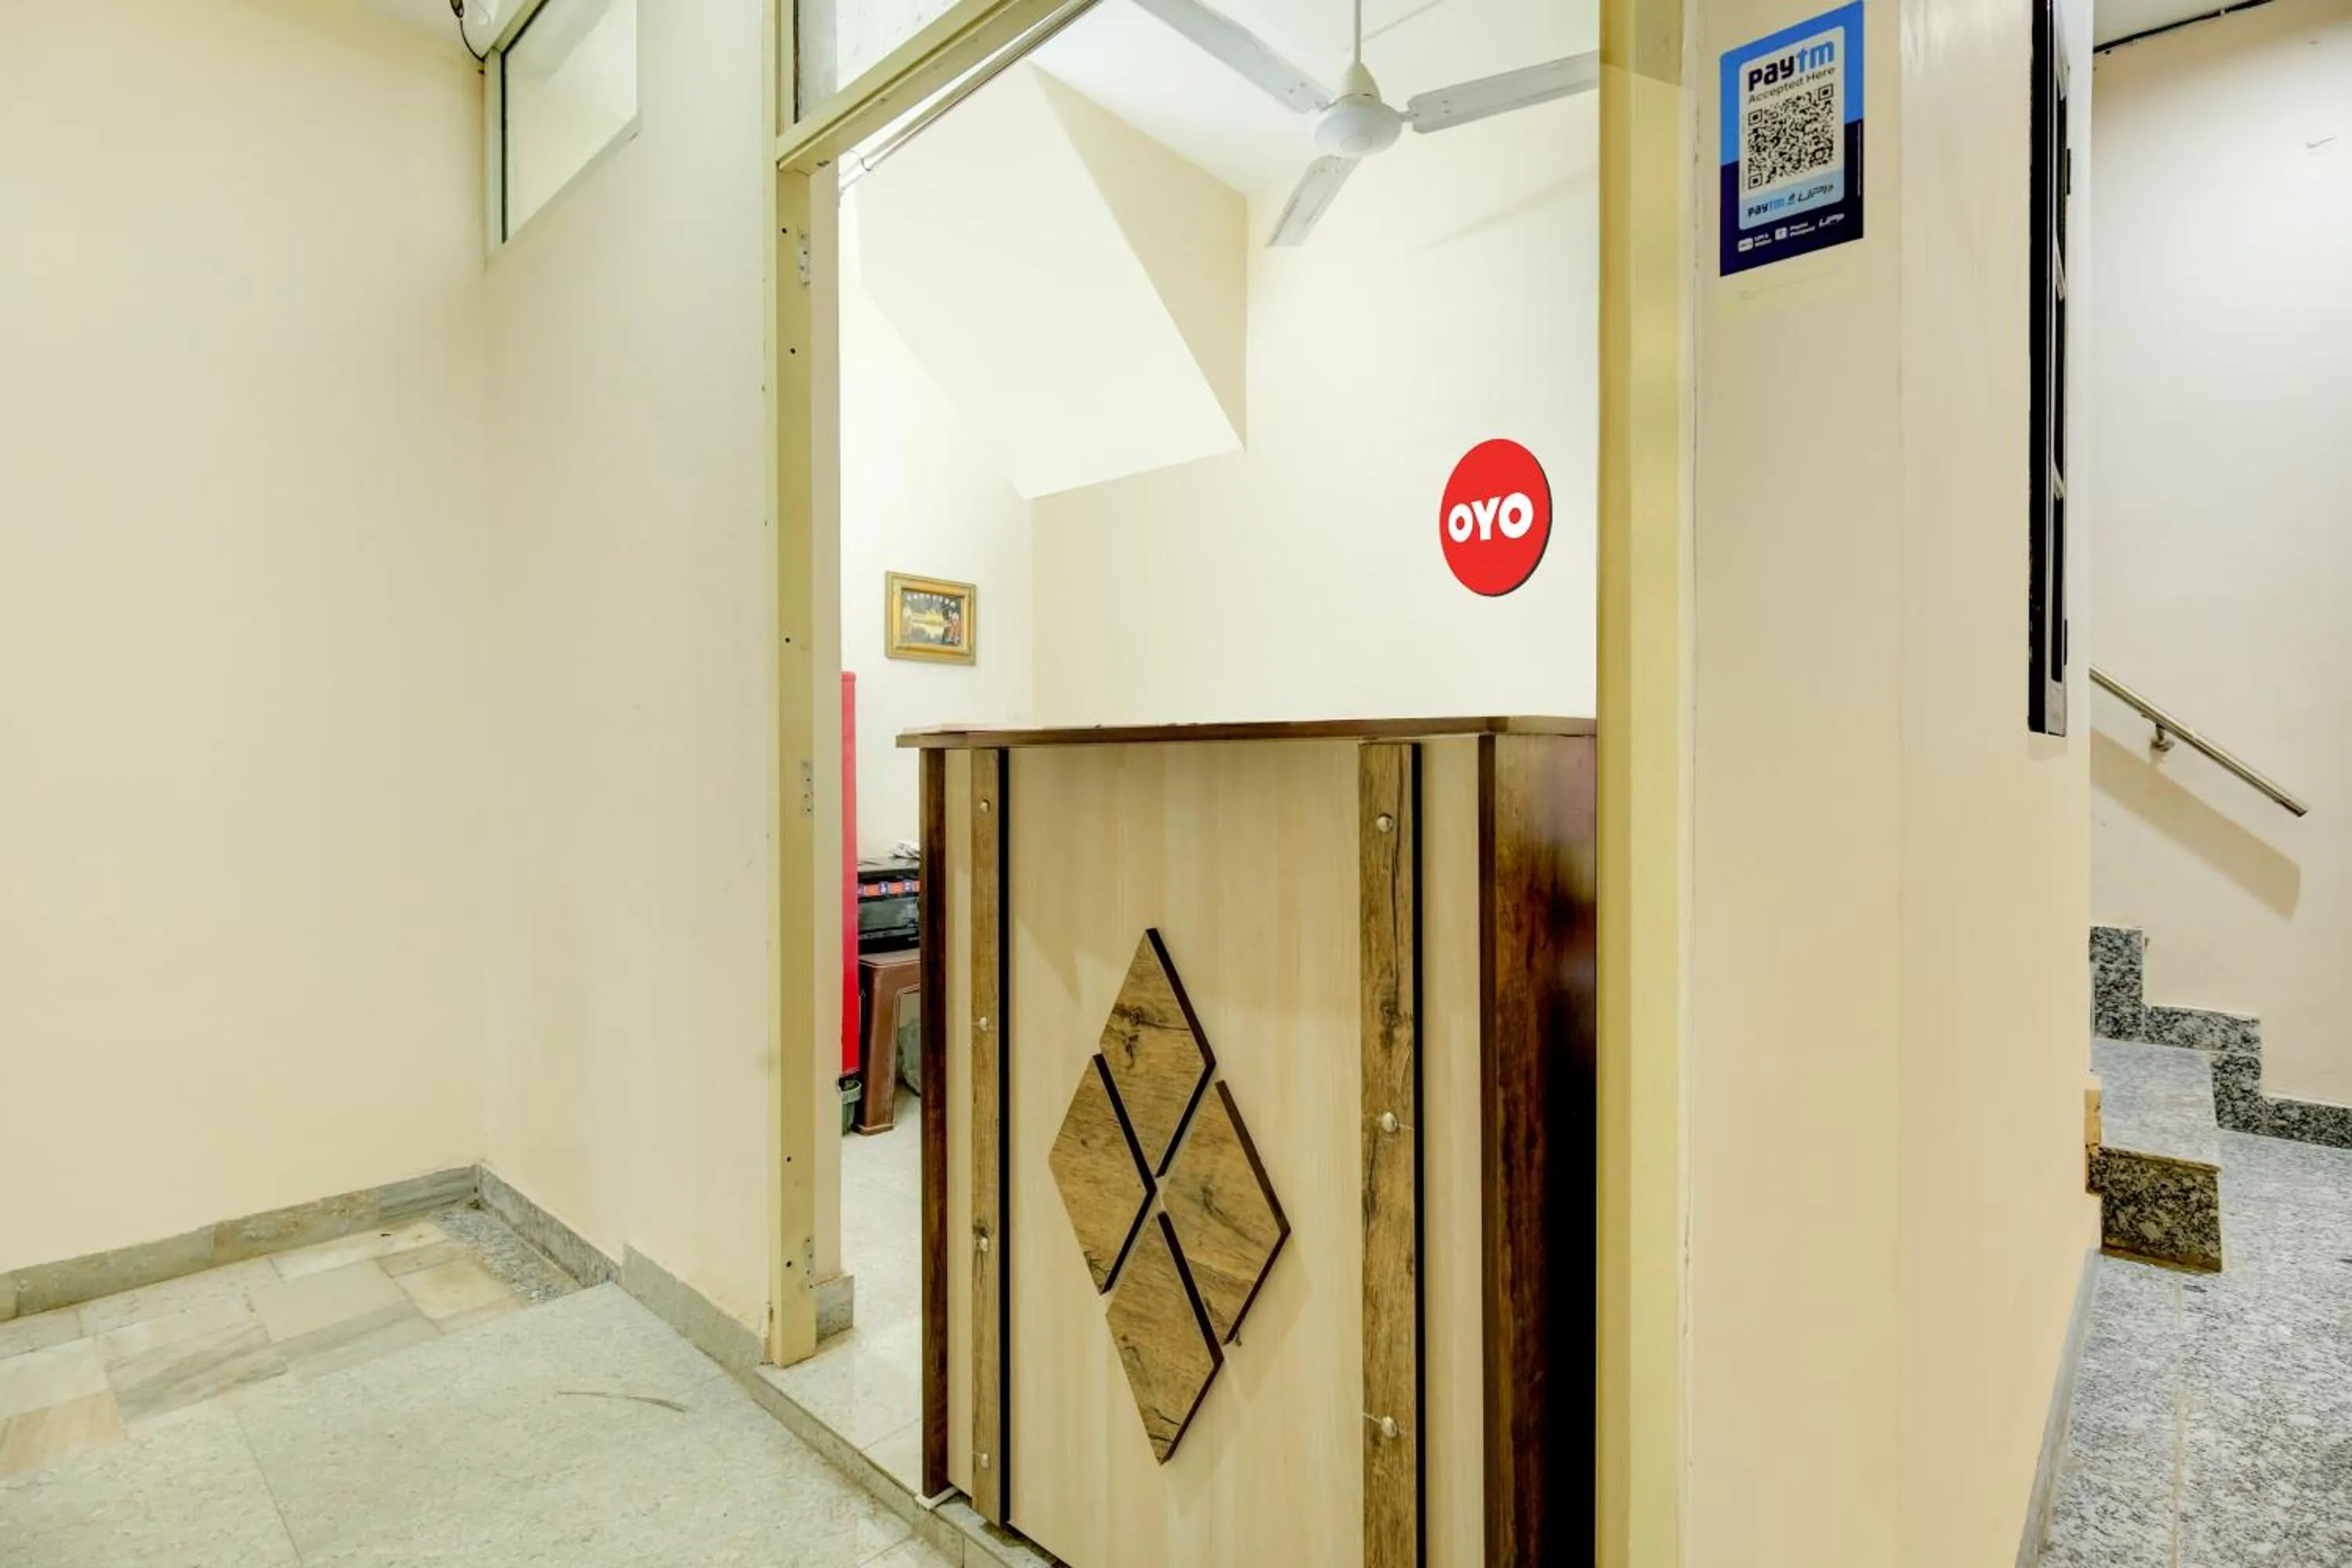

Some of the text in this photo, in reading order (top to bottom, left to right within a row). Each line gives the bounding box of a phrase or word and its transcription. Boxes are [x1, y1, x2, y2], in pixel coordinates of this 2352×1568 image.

[1748, 67, 1835, 104] Accepted Here
[1448, 492, 1534, 543] OYO
